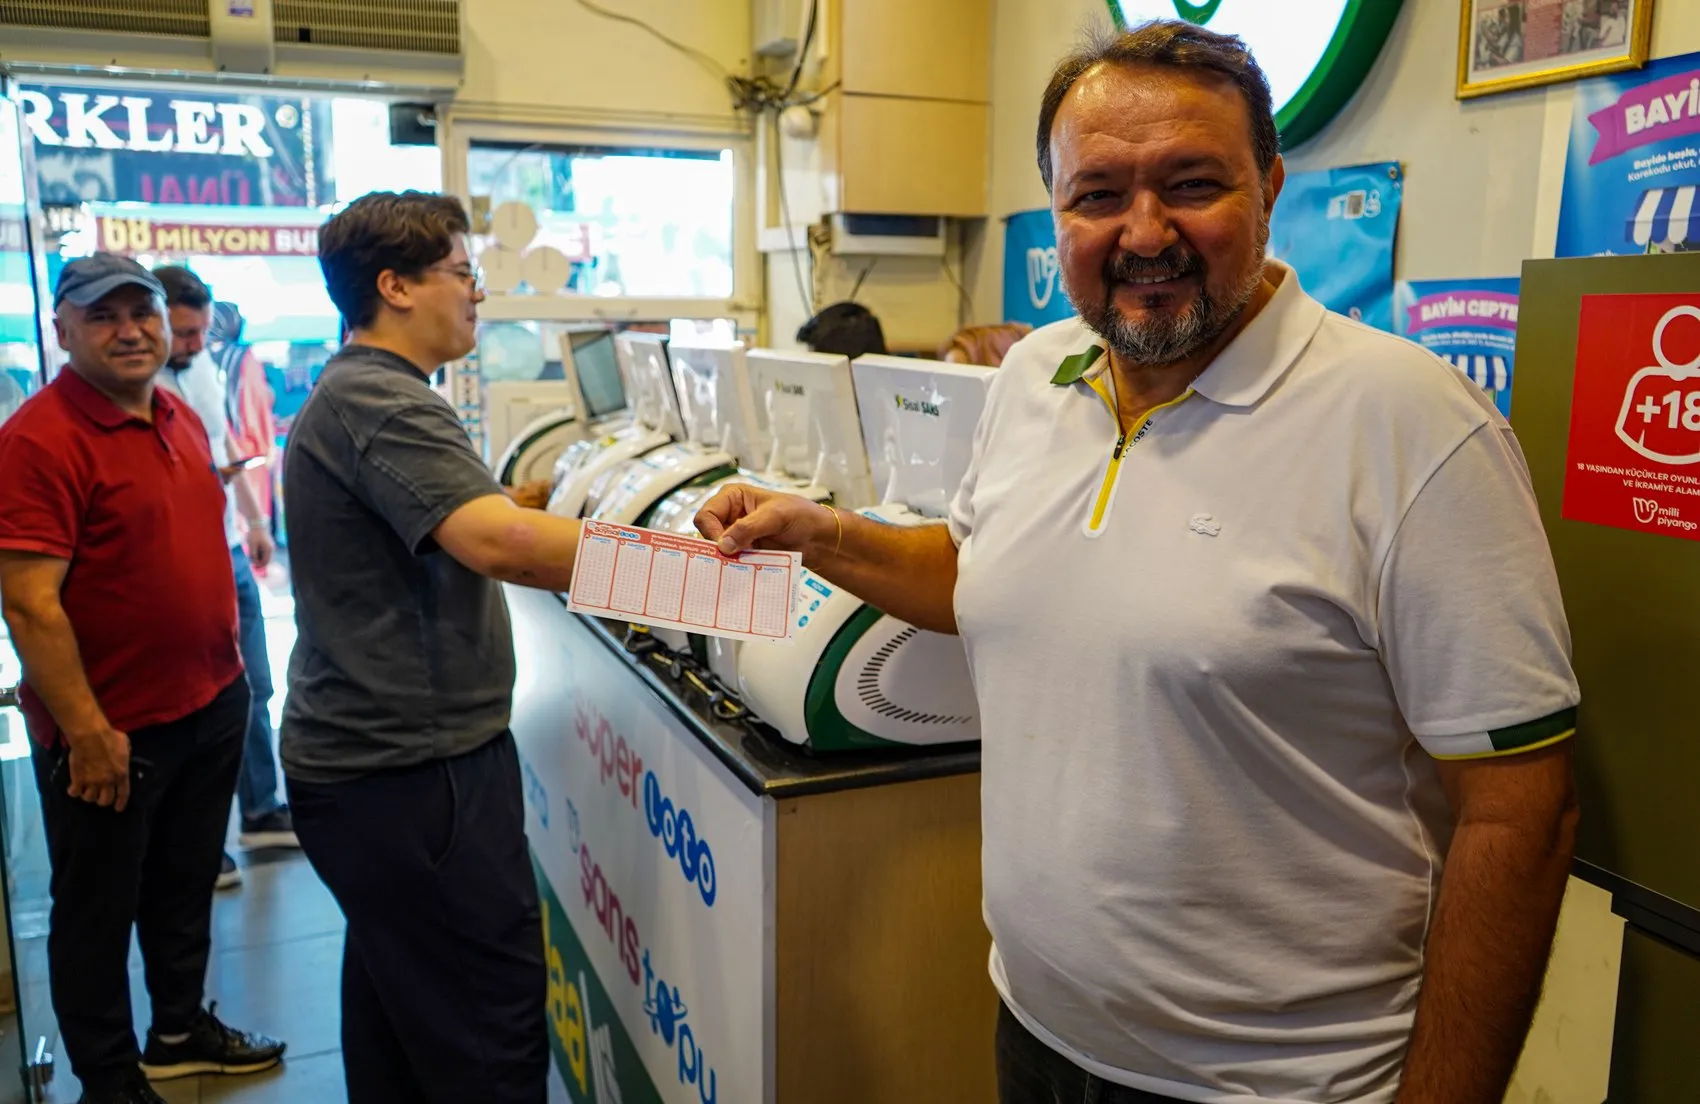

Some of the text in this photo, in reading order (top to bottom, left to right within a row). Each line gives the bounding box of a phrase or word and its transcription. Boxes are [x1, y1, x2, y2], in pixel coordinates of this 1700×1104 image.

[1625, 78, 1700, 134] BAYİ
[1634, 155, 1667, 170] Bayide
[1628, 165, 1671, 181] Karekodu
[156, 224, 269, 252] MİLYON
[1421, 296, 1466, 322] BAYİM
[1636, 390, 1700, 432] +18
[1577, 462, 1700, 485] 18 YAŞINDAN KÜÇÜKLER OYUNL
[1622, 479, 1633, 488] VE
[1635, 478, 1674, 493] İKRAMİYE
[1658, 507, 1680, 518] milli
[1657, 516, 1698, 531] piyango
